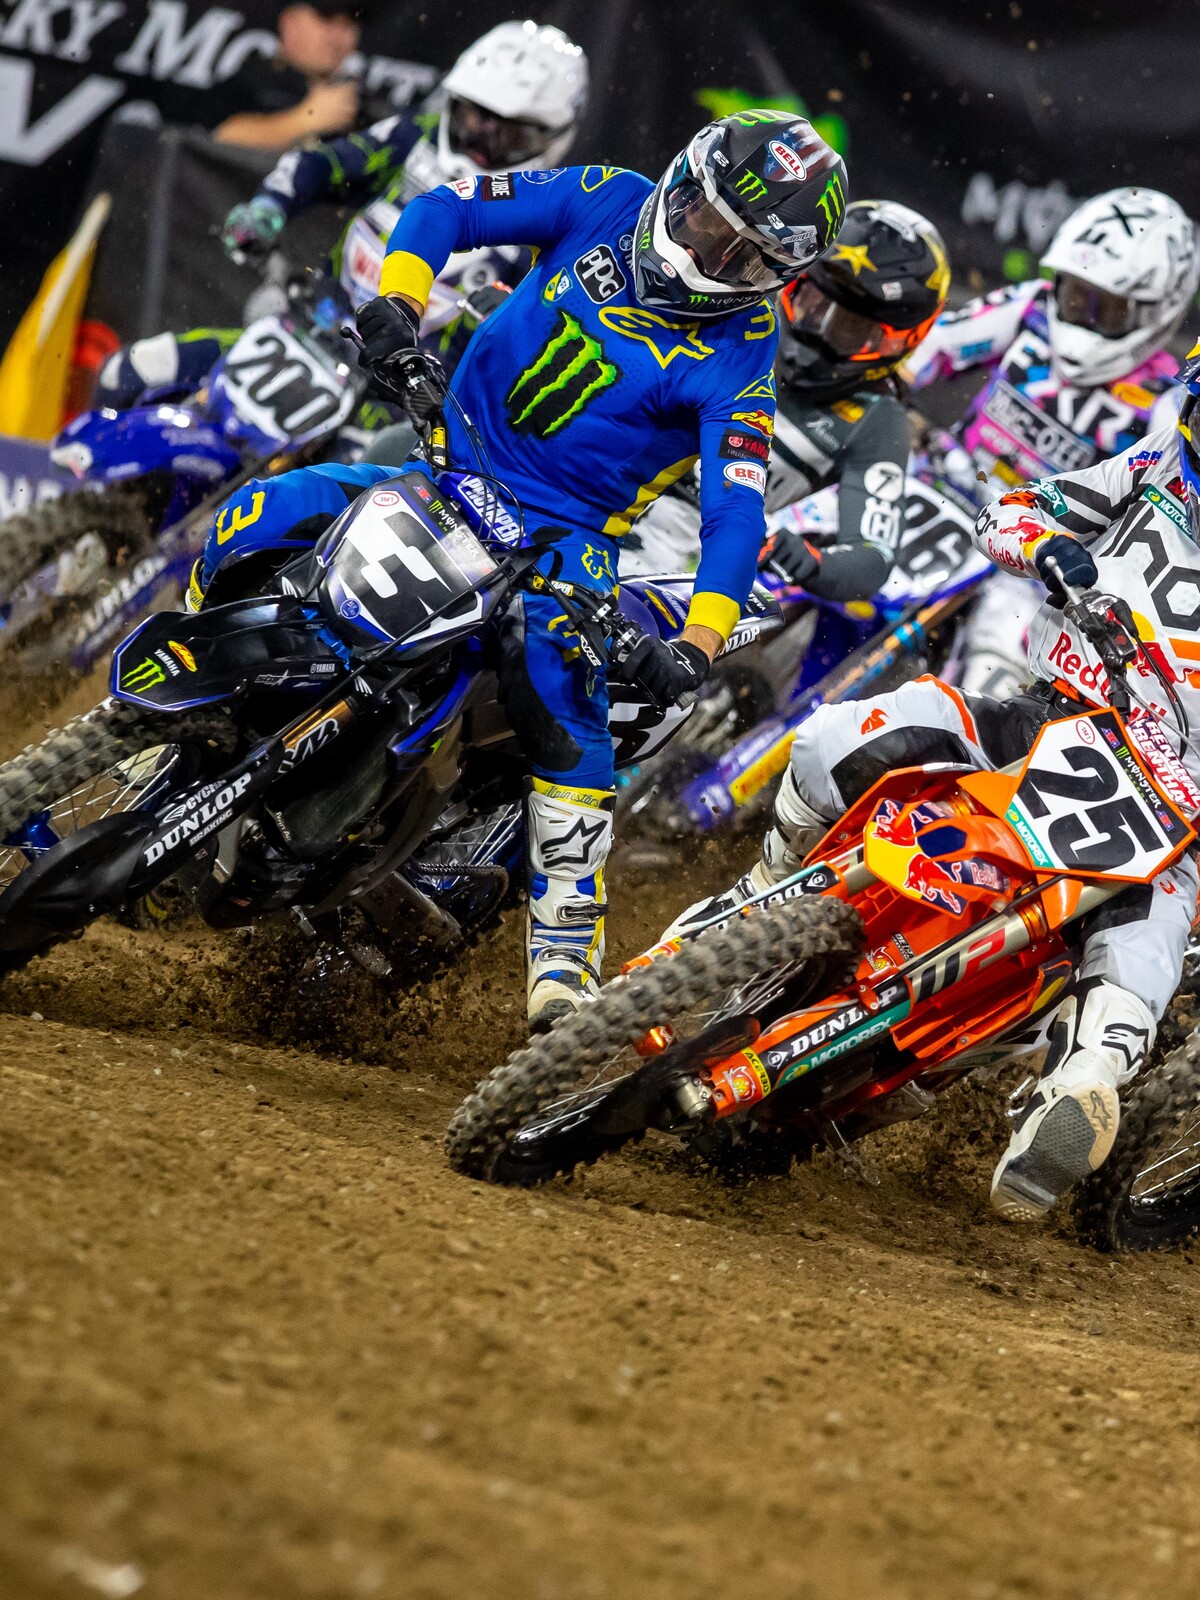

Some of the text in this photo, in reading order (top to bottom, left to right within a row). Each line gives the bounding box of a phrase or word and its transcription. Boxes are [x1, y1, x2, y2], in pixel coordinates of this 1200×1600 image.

[775, 145, 802, 177] BELL
[663, 264, 675, 277] BELL
[1159, 499, 1193, 535] MOTORE
[337, 511, 480, 640] 3
[154, 649, 181, 677] YAMAHA
[316, 663, 335, 674] YAMAHA
[1048, 630, 1105, 691] Red
[544, 784, 601, 810] Alpinestars
[1125, 755, 1162, 809] MONSTER
[144, 772, 252, 867] DUNLOP
[189, 808, 234, 848] BRAKING
[1017, 745, 1166, 873] 25
[1016, 820, 1050, 867] MOTOREX
[810, 1016, 896, 1069] MOTOREX
